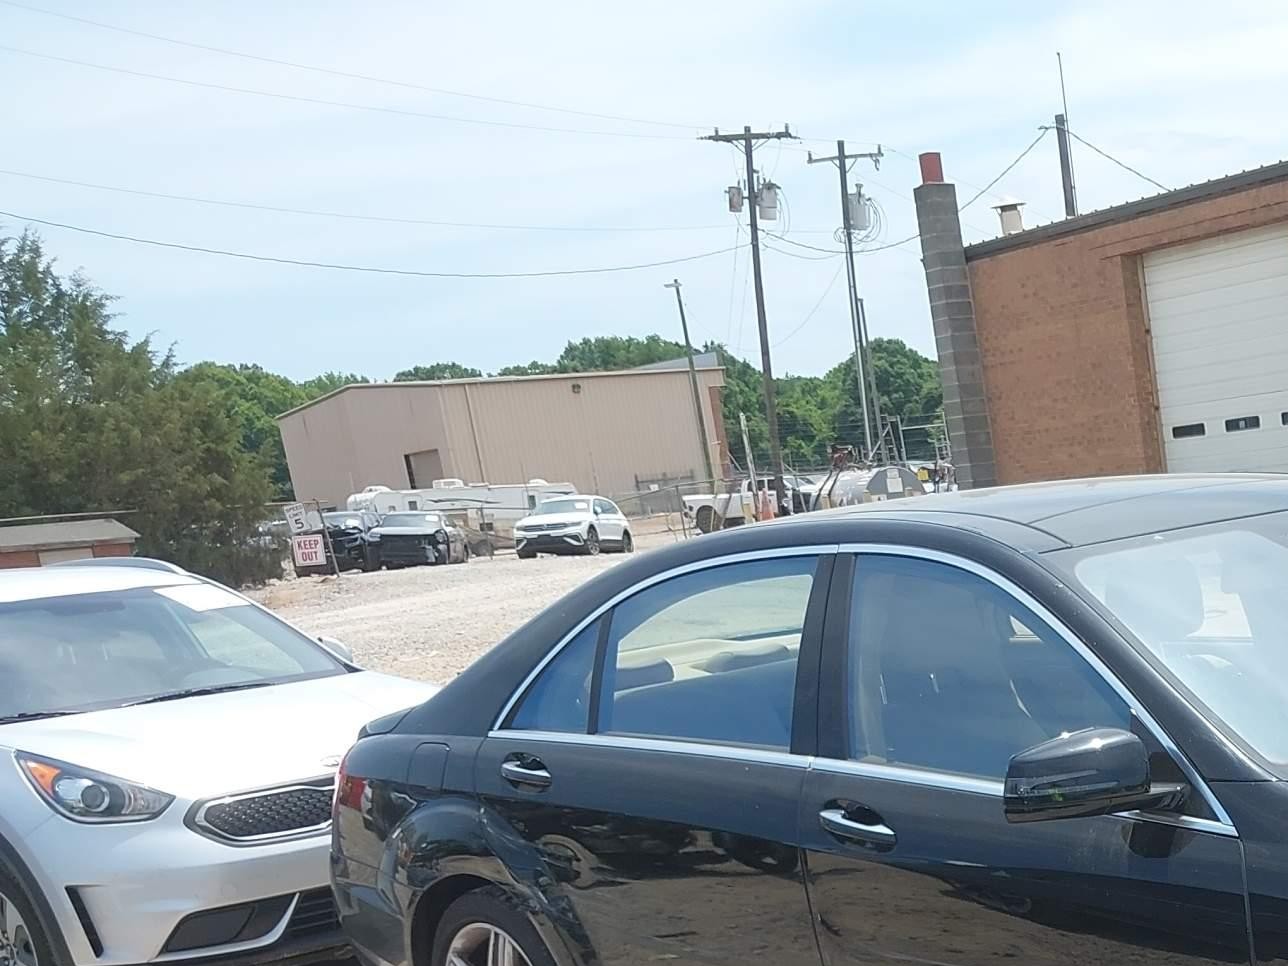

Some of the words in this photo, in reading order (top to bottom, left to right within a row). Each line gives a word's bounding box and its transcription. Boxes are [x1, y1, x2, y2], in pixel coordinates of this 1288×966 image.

[295, 519, 304, 529] 5
[297, 540, 319, 550] KEEP
[302, 551, 318, 561] OUT
